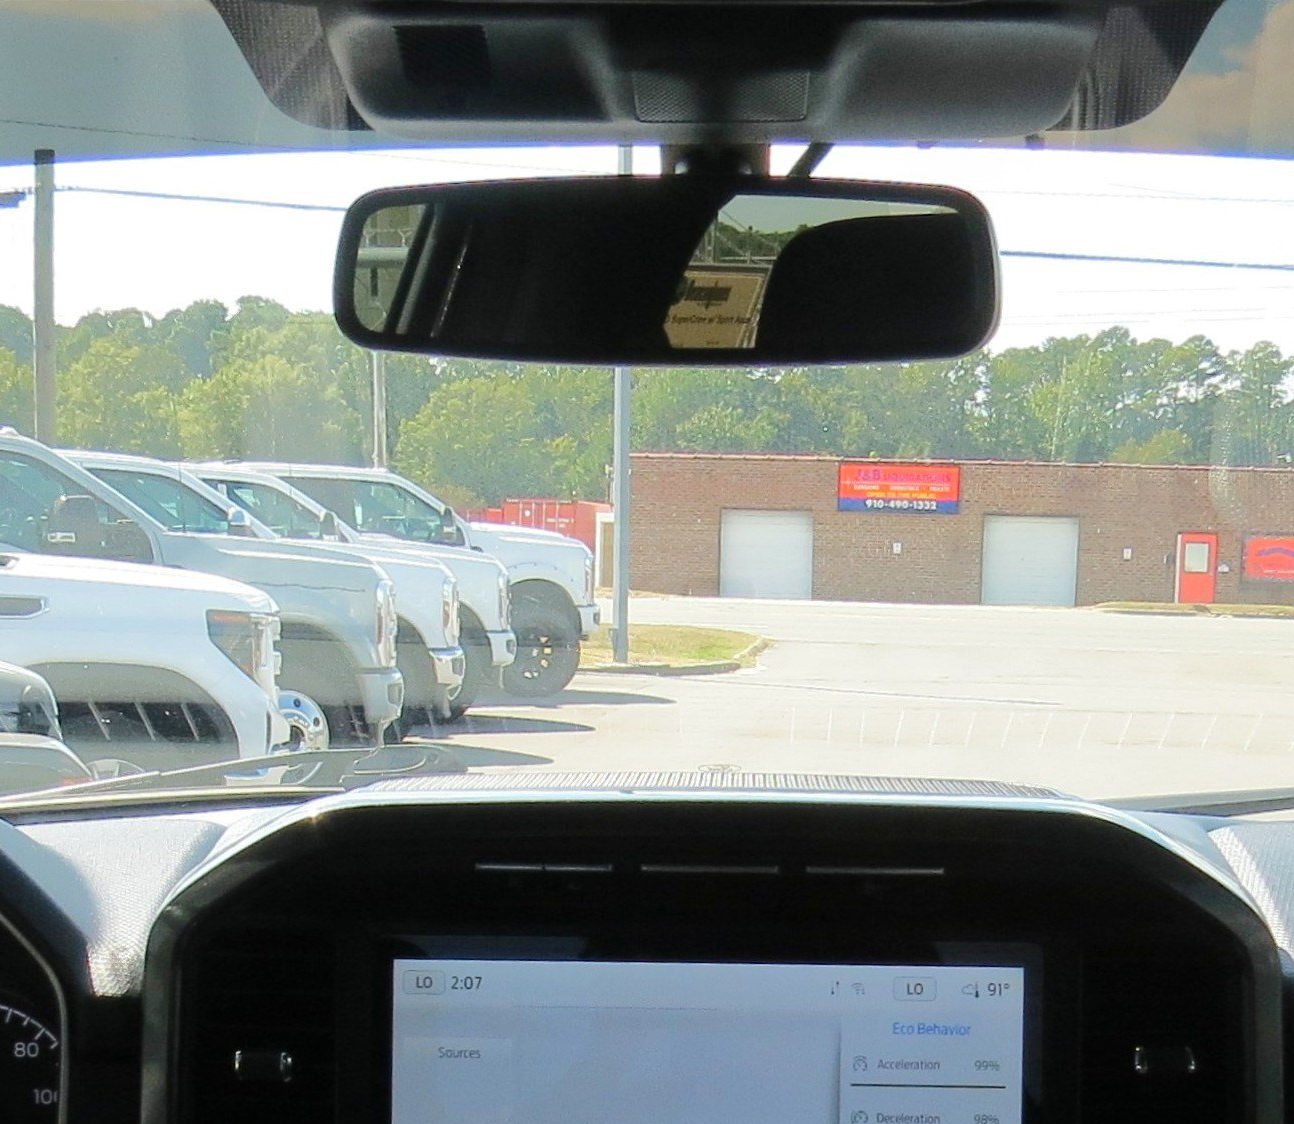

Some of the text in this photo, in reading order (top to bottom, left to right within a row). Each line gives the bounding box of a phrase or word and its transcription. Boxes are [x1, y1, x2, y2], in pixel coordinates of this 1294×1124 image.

[865, 499, 938, 511] 910-490-1332
[415, 975, 483, 991] LO 2:07
[905, 982, 924, 996] LO
[987, 981, 1011, 998] 91°
[892, 1022, 972, 1036] Eco Behavior
[14, 1042, 38, 1057] 80
[438, 1046, 481, 1060] Sources
[876, 1057, 941, 1071] Acceleration
[876, 1111, 941, 1124] Deceleration
